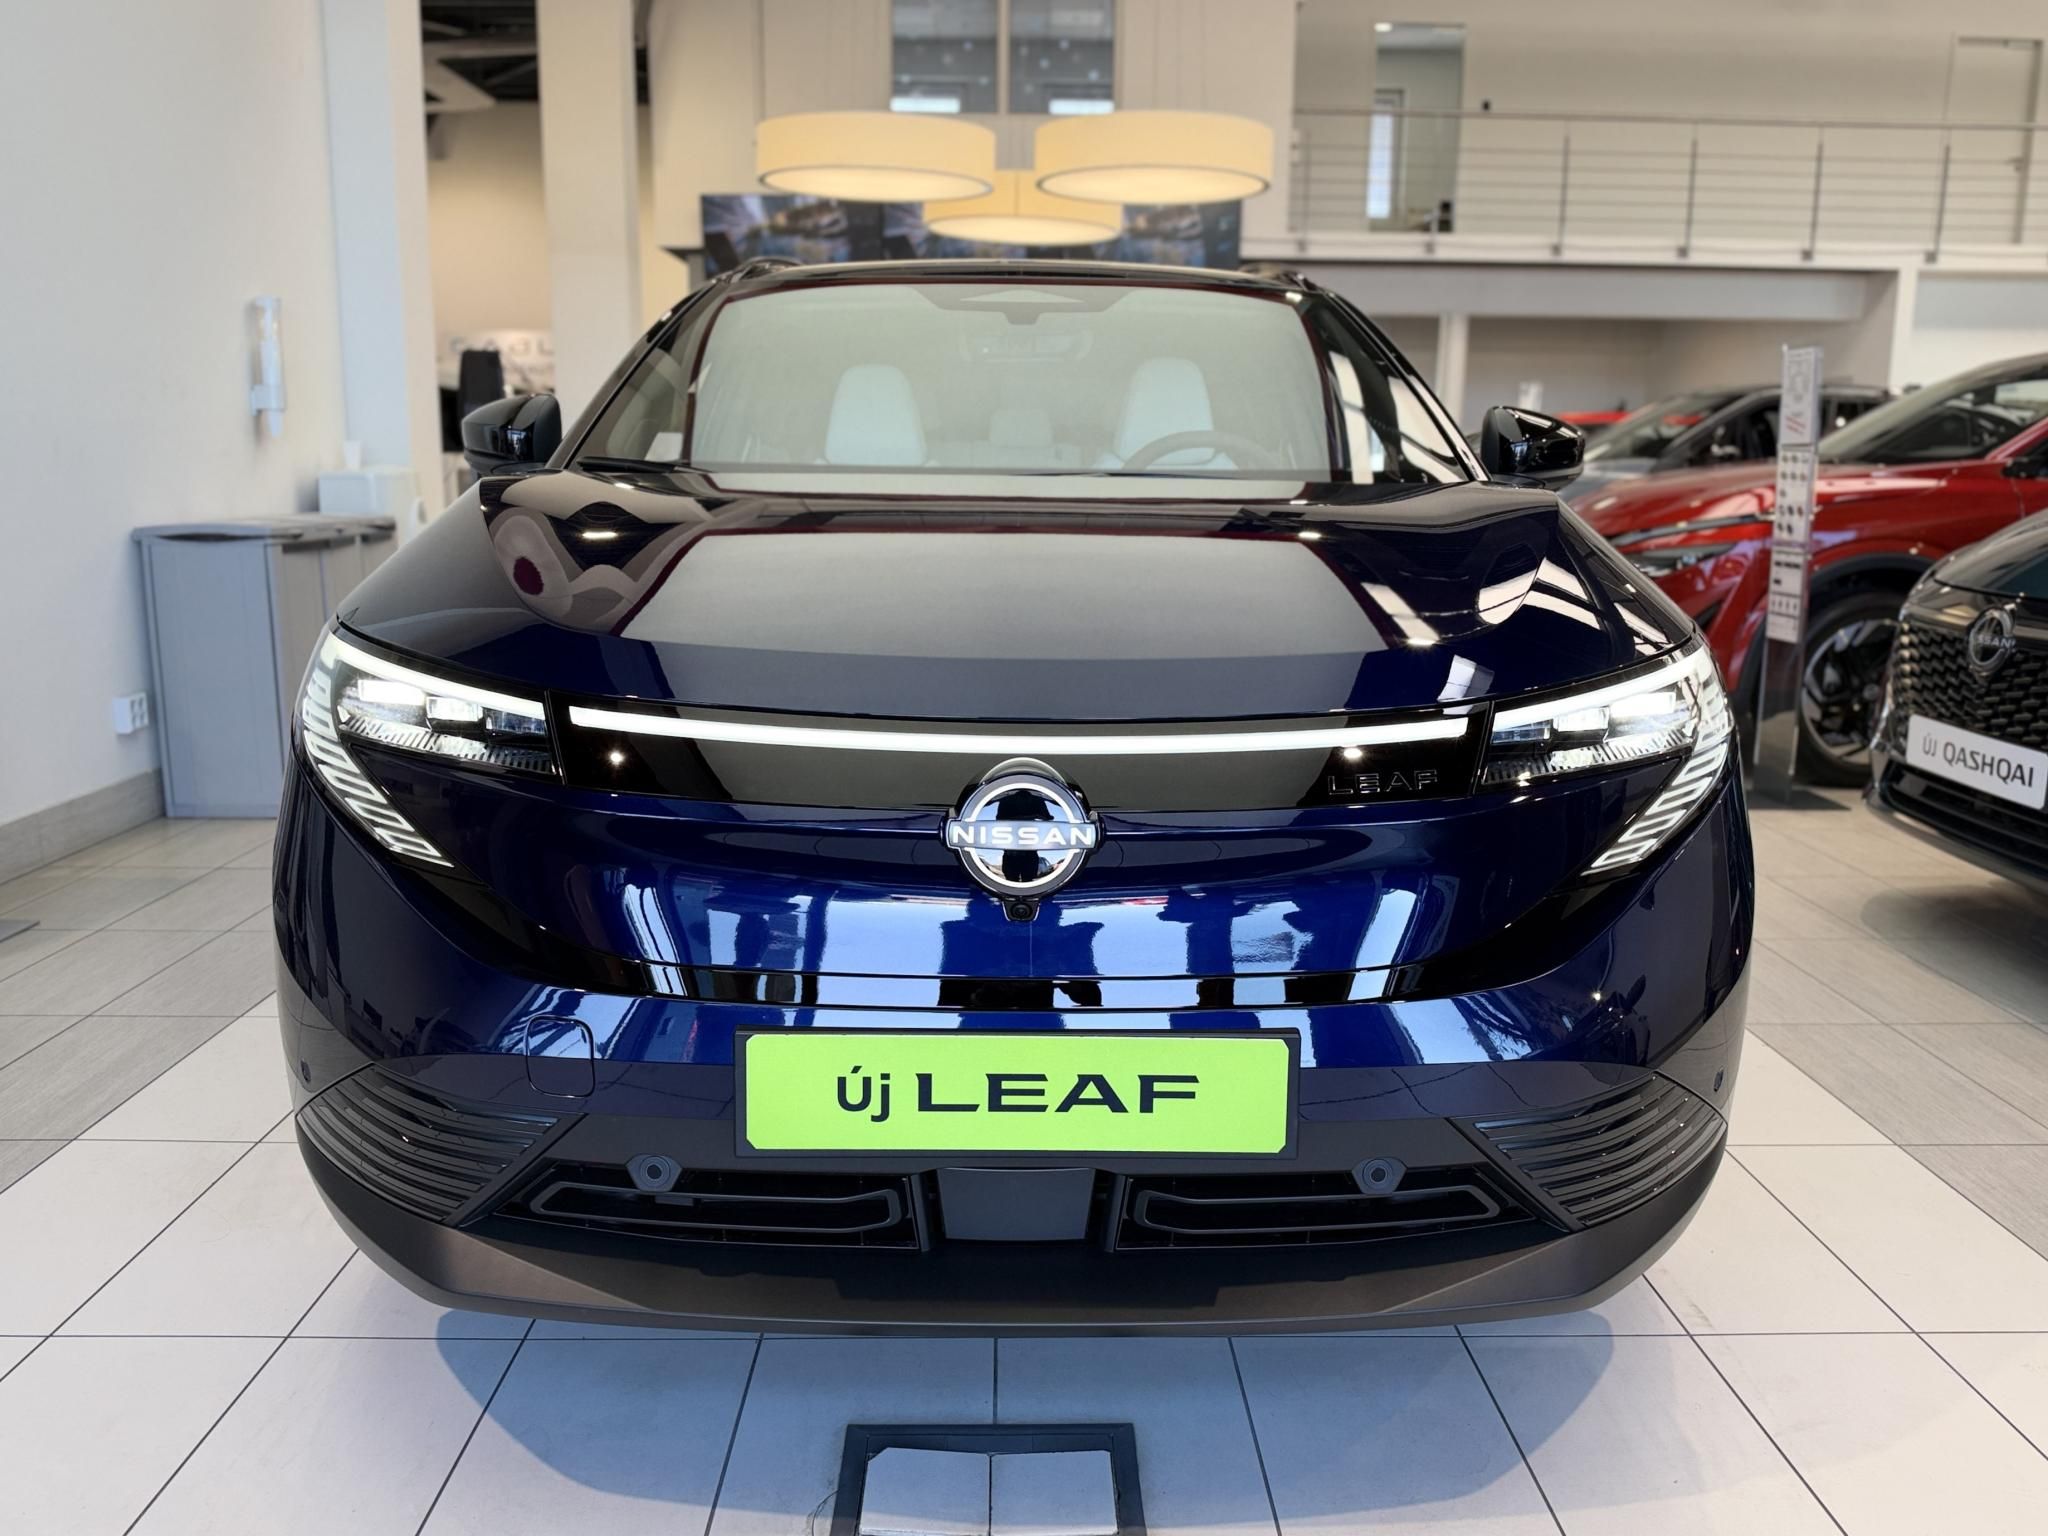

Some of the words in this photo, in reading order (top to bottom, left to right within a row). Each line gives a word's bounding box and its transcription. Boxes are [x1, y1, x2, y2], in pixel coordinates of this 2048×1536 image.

[1942, 741, 2034, 788] QASHQAI
[1327, 769, 1438, 795] LEAF
[952, 825, 1093, 846] NISSAN
[915, 1073, 1200, 1114] LEAF
